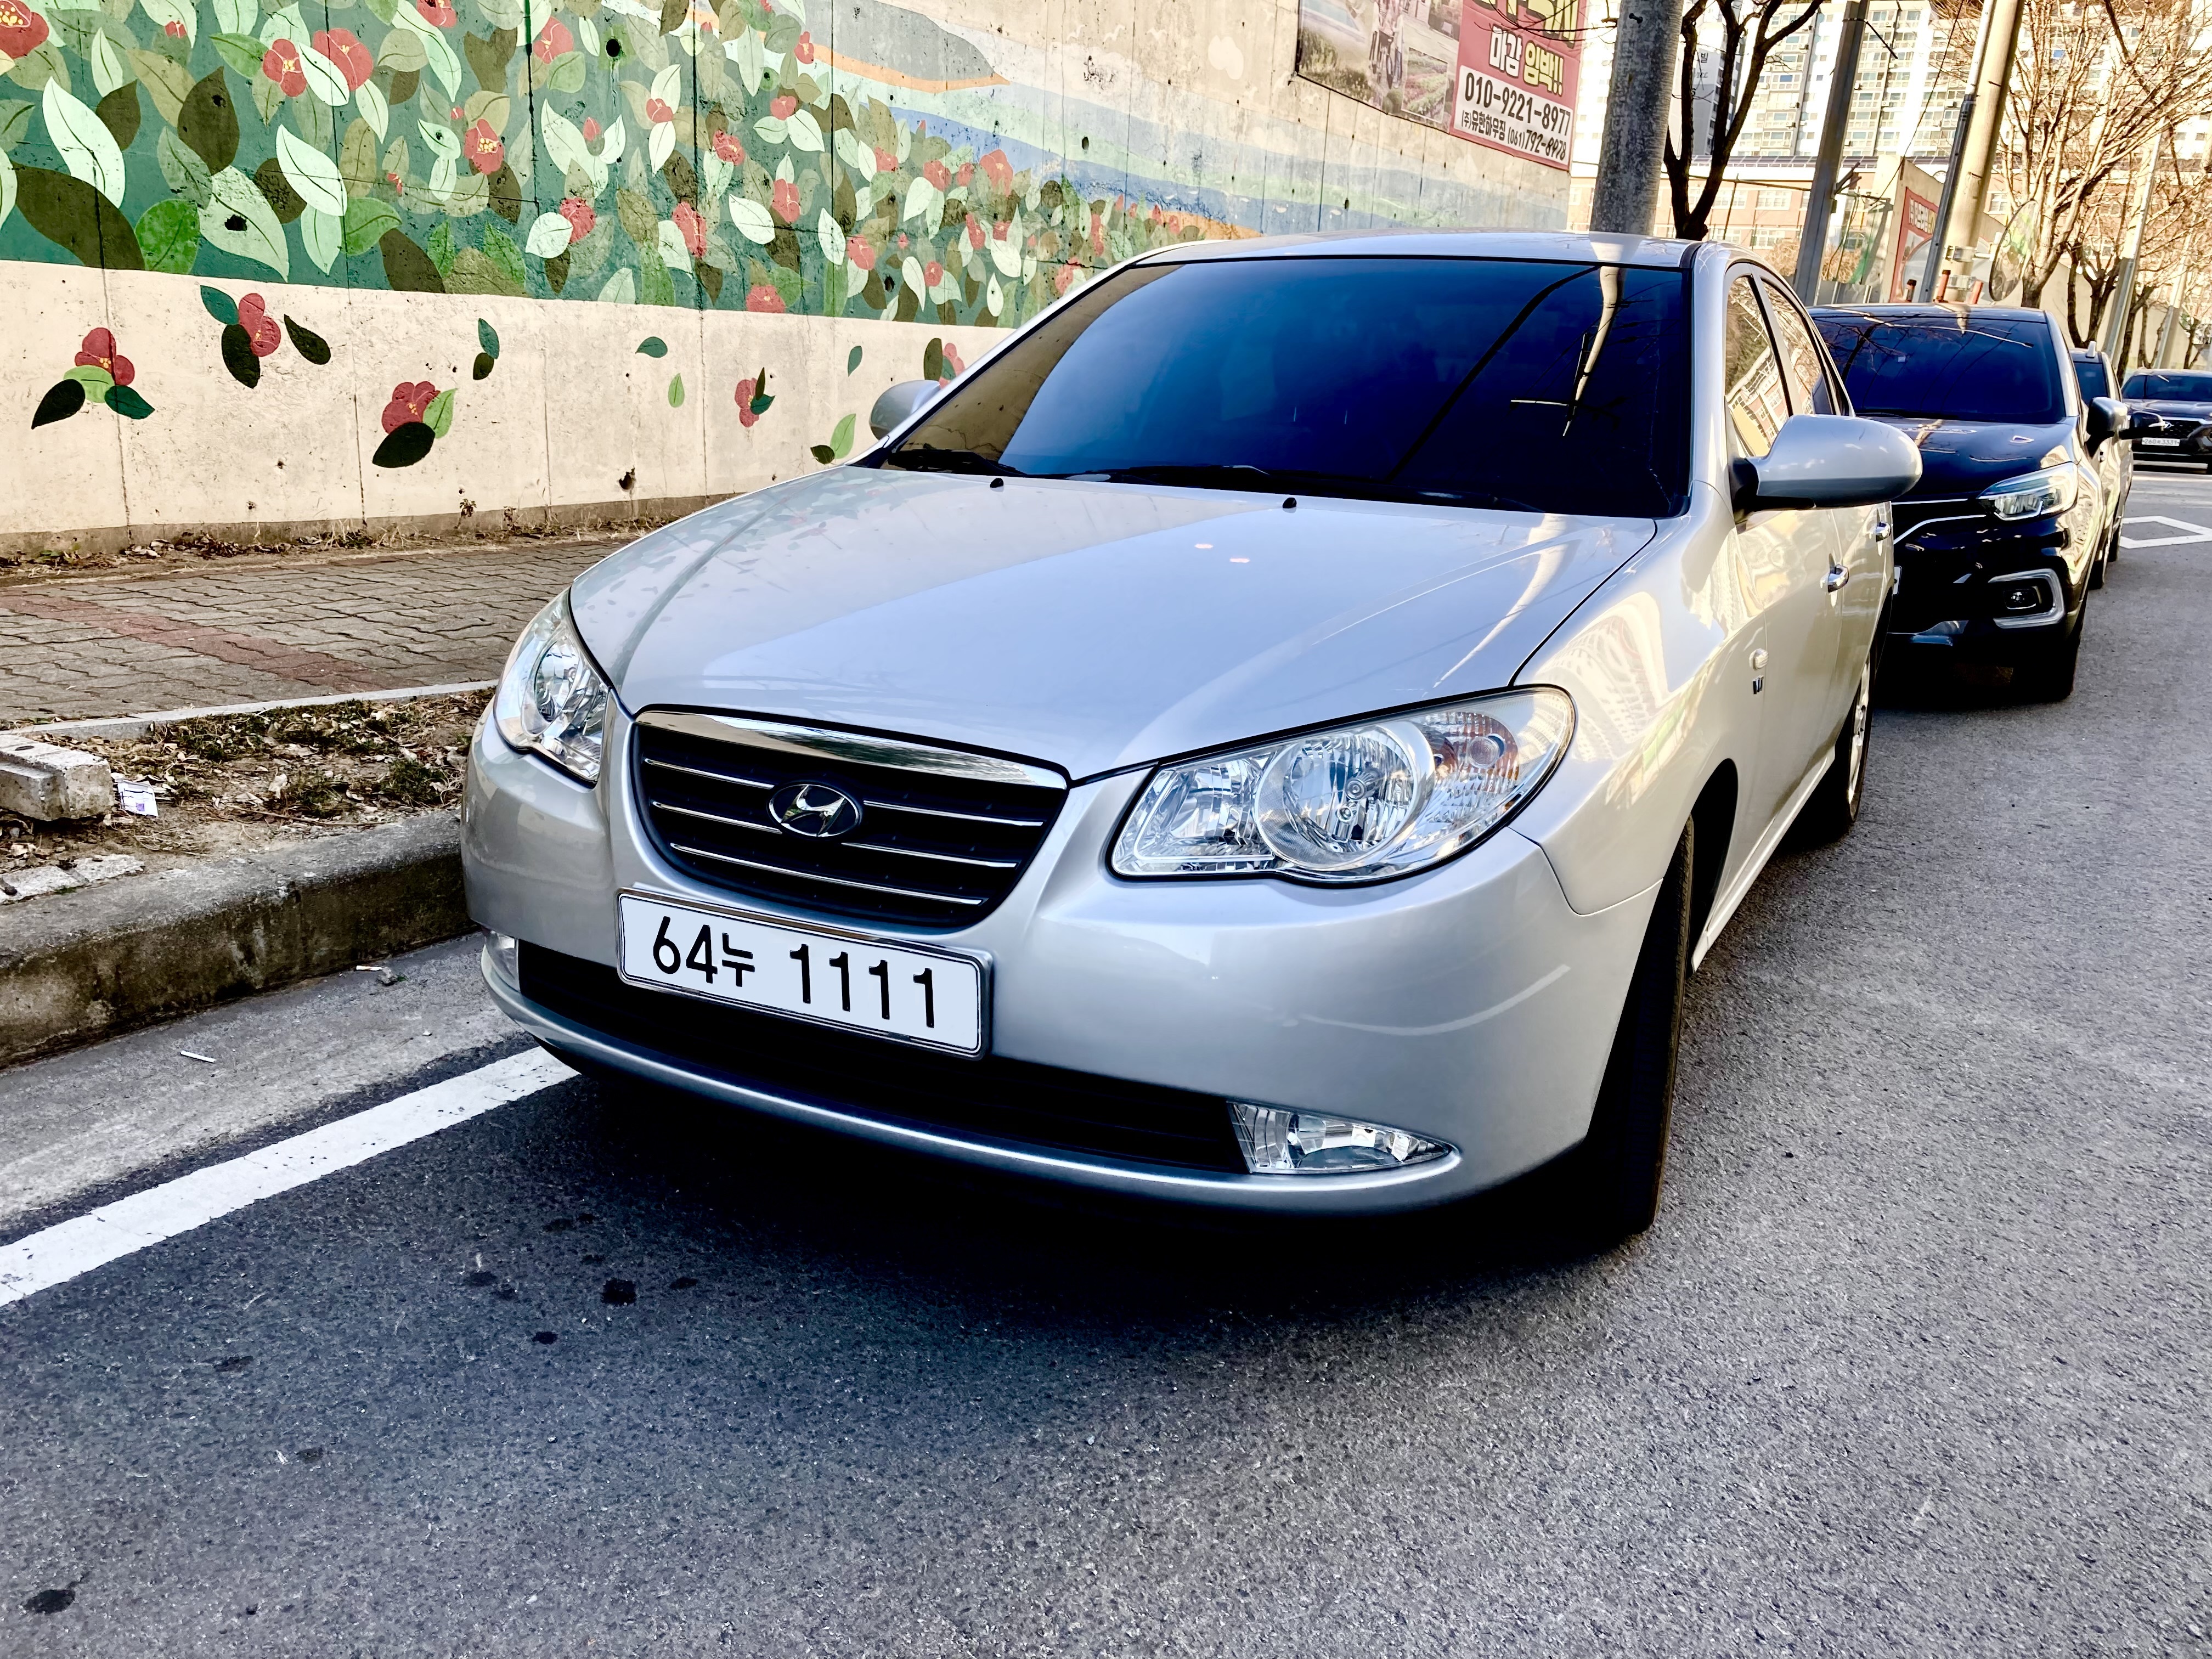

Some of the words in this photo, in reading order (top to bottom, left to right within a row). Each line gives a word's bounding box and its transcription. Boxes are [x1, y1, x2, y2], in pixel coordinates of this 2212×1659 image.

[1489, 25, 1522, 77] 마감
[1523, 41, 1564, 97] 임박!!
[1462, 110, 1506, 141] (주)유한하우징
[1508, 127, 1566, 161] (061)792-8978
[1465, 72, 1571, 136] 010-9221-8977
[653, 916, 755, 987] 64누
[789, 944, 934, 1029] 1111
